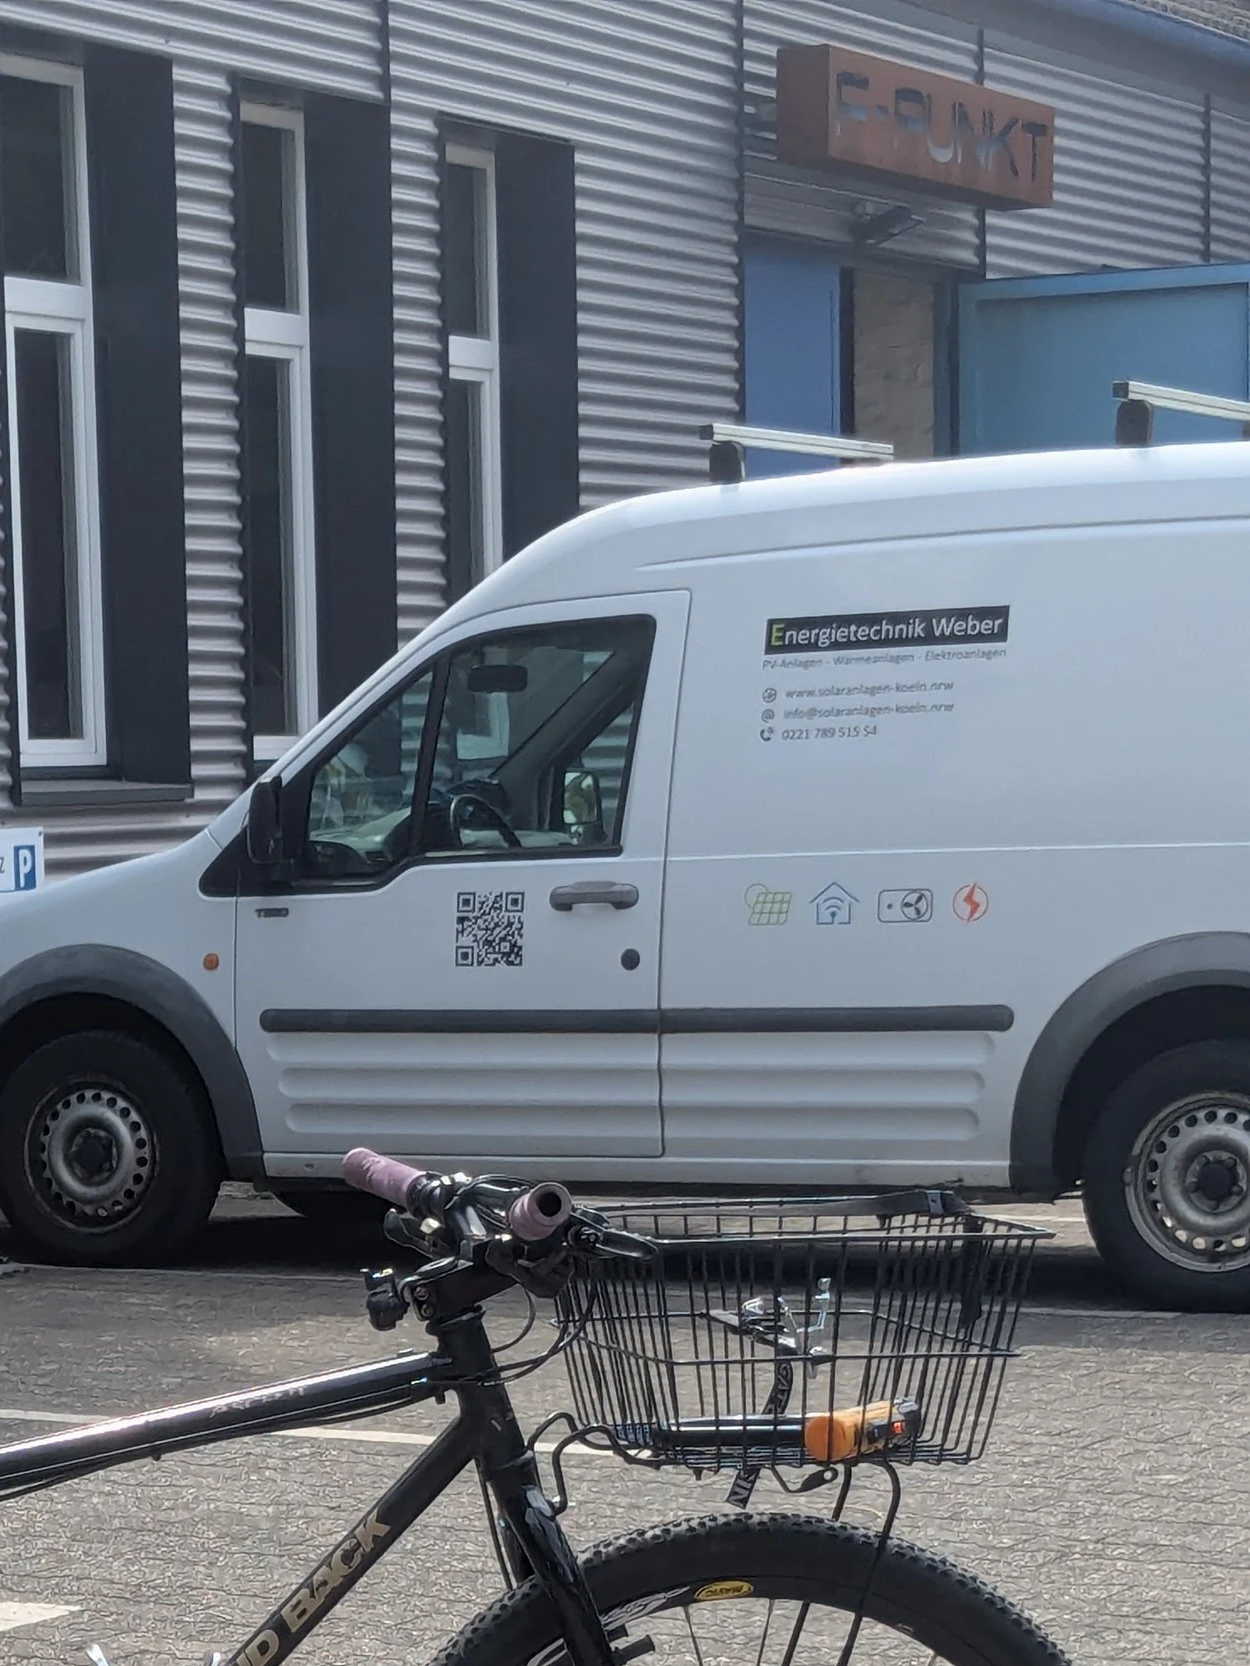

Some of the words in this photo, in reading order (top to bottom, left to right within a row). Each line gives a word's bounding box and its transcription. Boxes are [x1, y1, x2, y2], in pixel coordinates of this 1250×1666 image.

[836, 71, 1048, 182] F-PUNKT
[770, 618, 926, 648] Energietechnik
[932, 615, 1004, 636] Weber
[781, 729, 810, 741] 0221
[281, 1508, 391, 1633] BACK
